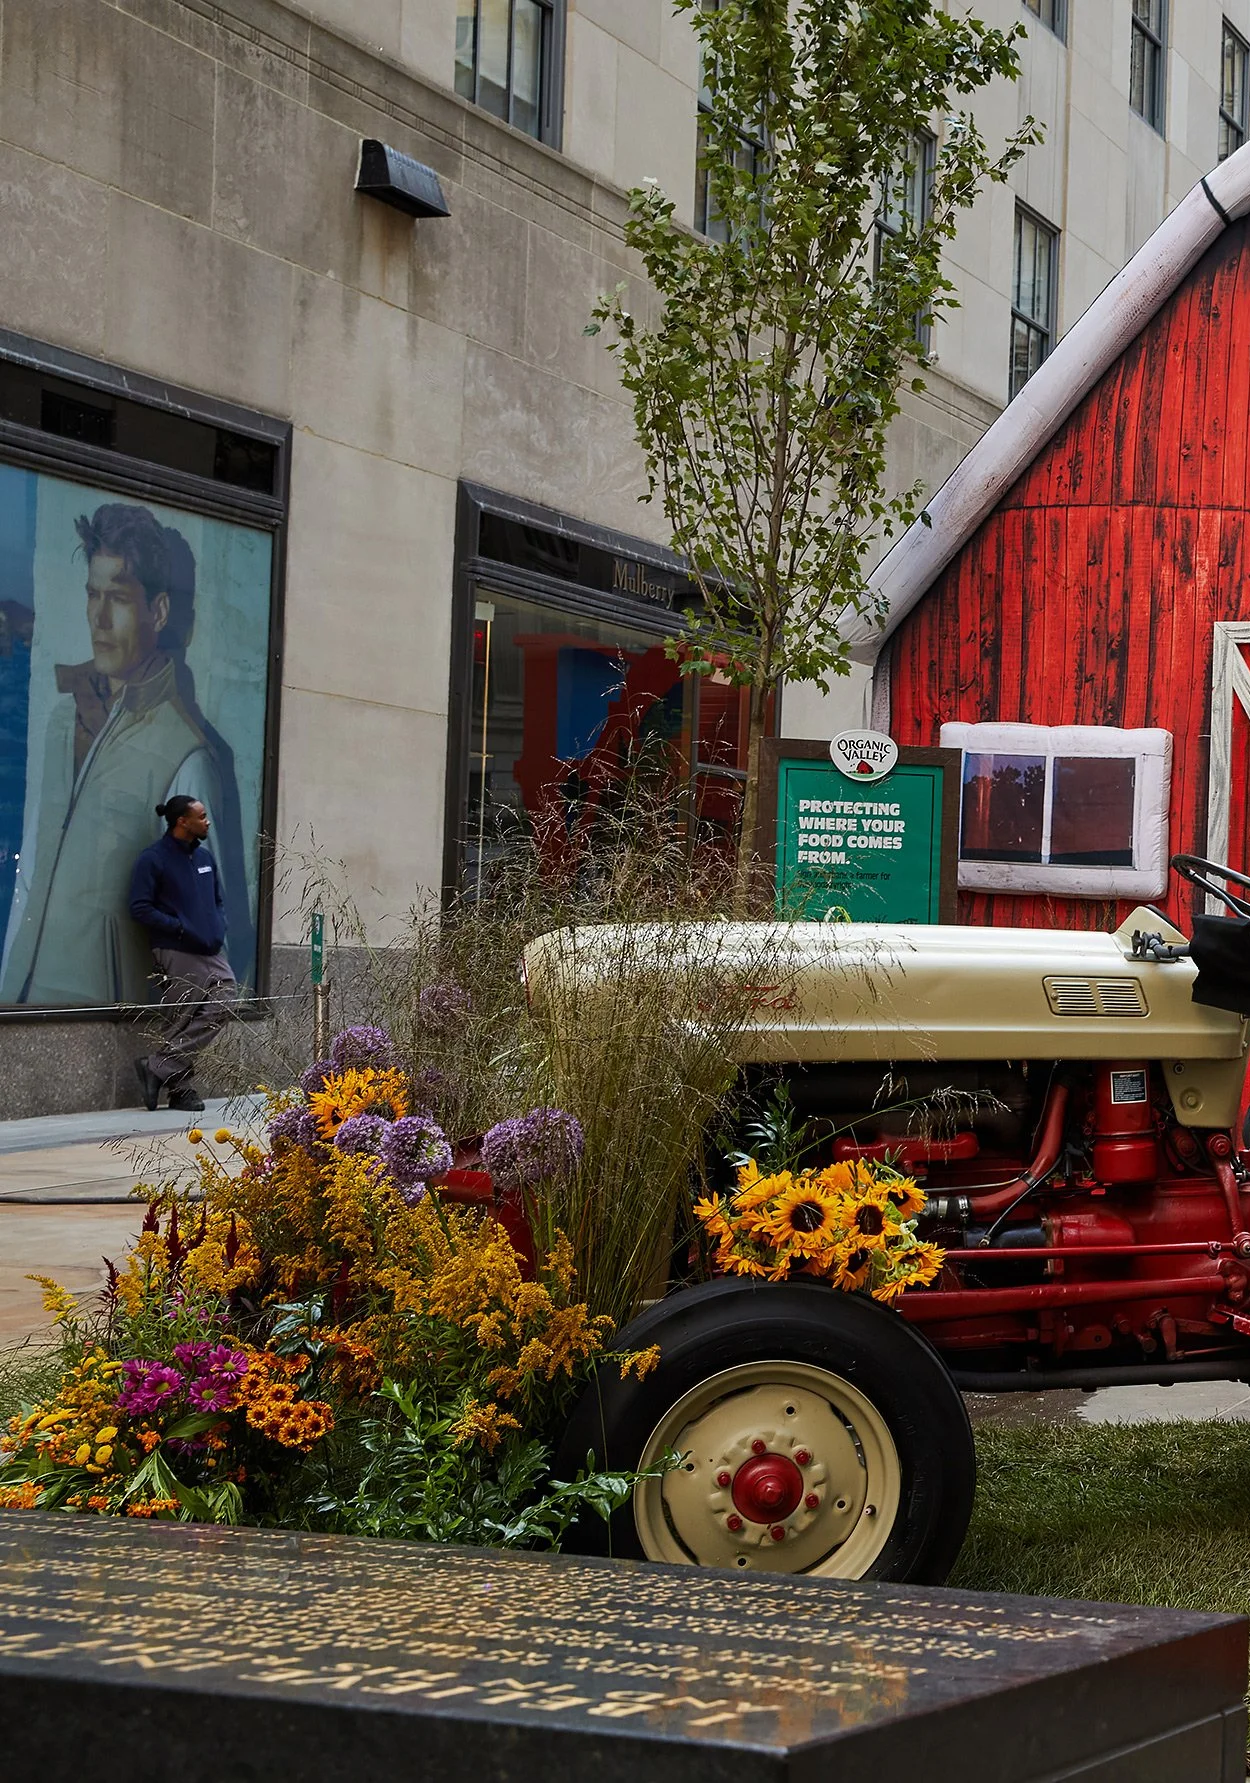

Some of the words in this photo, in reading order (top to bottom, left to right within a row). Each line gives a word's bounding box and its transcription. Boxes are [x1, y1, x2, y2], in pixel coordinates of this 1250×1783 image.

[613, 559, 675, 610] Mulberry
[837, 738, 891, 754] ORGANIC
[842, 749, 887, 762] VALLEY
[799, 799, 901, 816] PROTECTING
[798, 816, 857, 832] WHERE
[861, 818, 905, 833] YOUR
[798, 833, 844, 848] FOOD
[847, 835, 903, 850] COMES
[797, 850, 851, 865] FROM.
[856, 871, 879, 880] farmer
[880, 871, 891, 881] for
